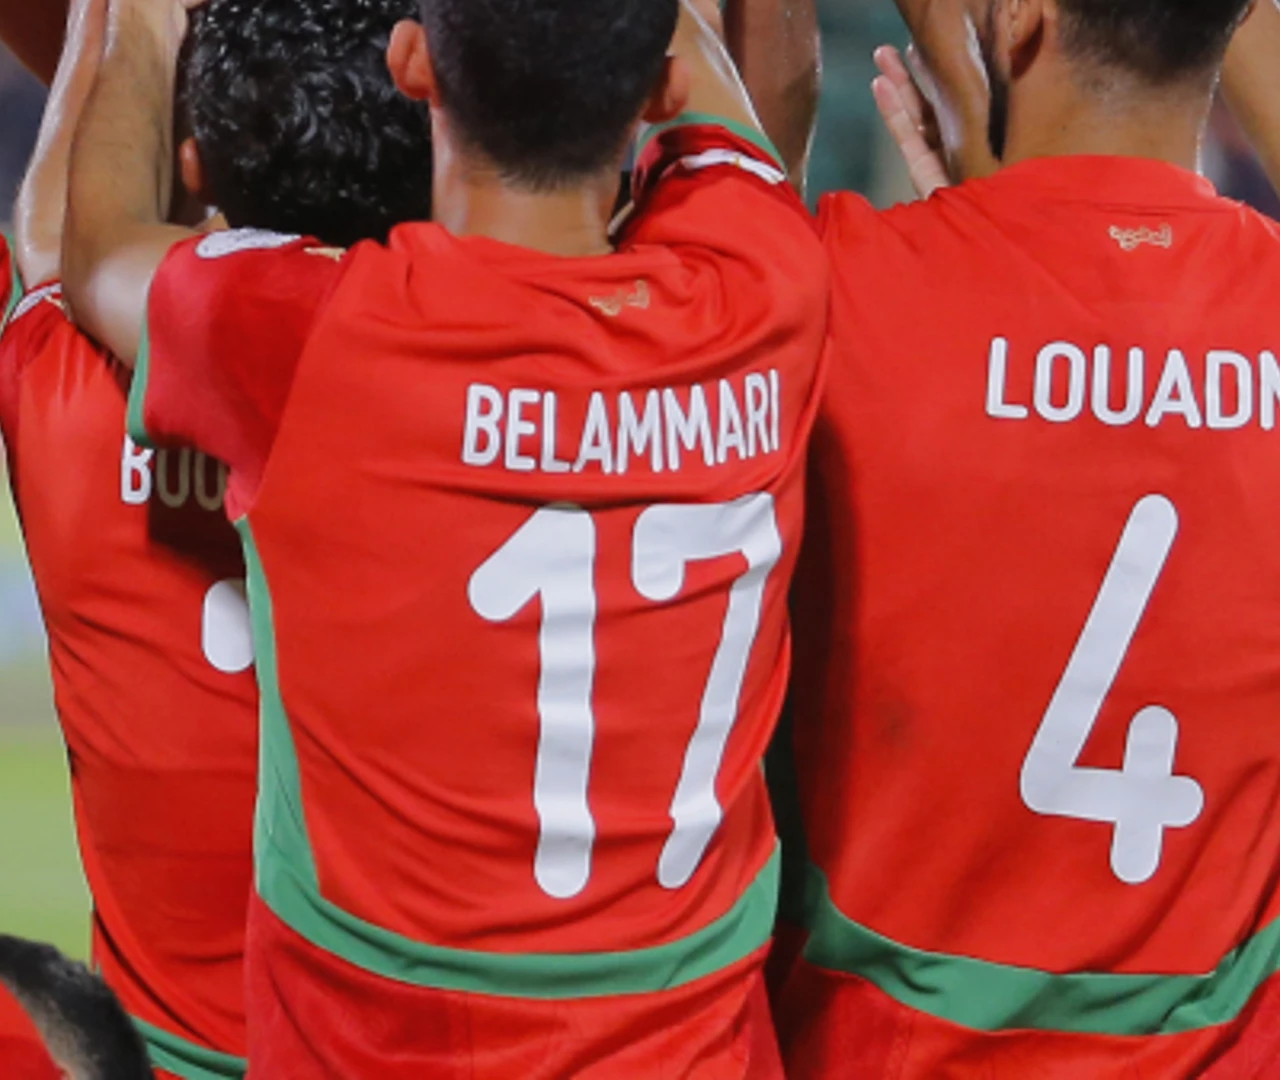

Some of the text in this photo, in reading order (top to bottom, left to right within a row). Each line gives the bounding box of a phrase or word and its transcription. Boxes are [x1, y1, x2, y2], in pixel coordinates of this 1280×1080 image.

[461, 369, 780, 475] BELAMMARI
[467, 491, 782, 899] 17
[1019, 493, 1205, 883] 4
